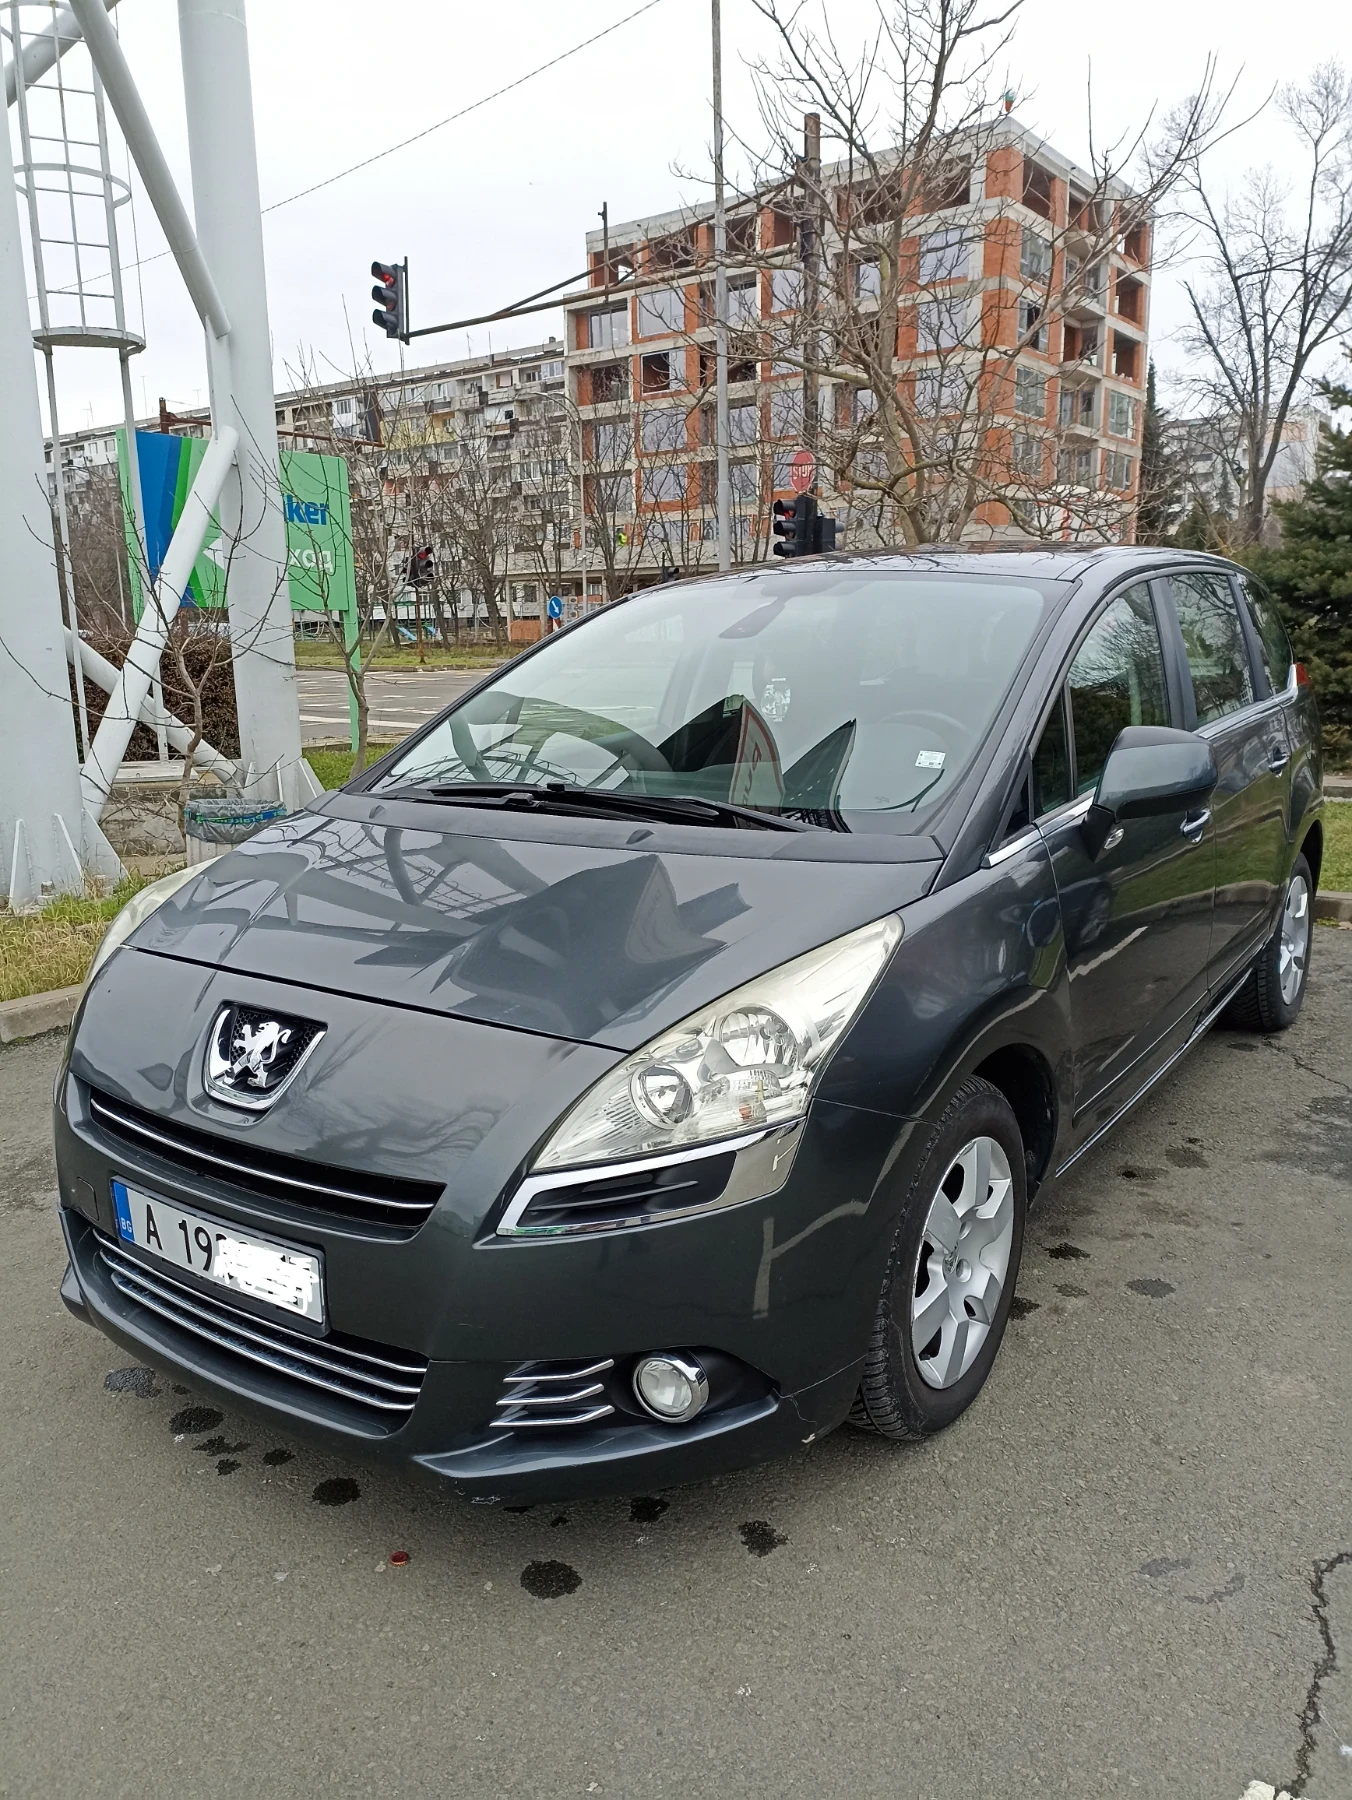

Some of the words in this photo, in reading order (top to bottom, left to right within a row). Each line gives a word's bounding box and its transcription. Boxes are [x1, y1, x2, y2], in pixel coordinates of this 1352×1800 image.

[793, 462, 813, 480] STOP
[282, 493, 329, 526] ker
[287, 548, 334, 574] ход
[120, 1217, 133, 1234] BG
[146, 1203, 163, 1251] A
